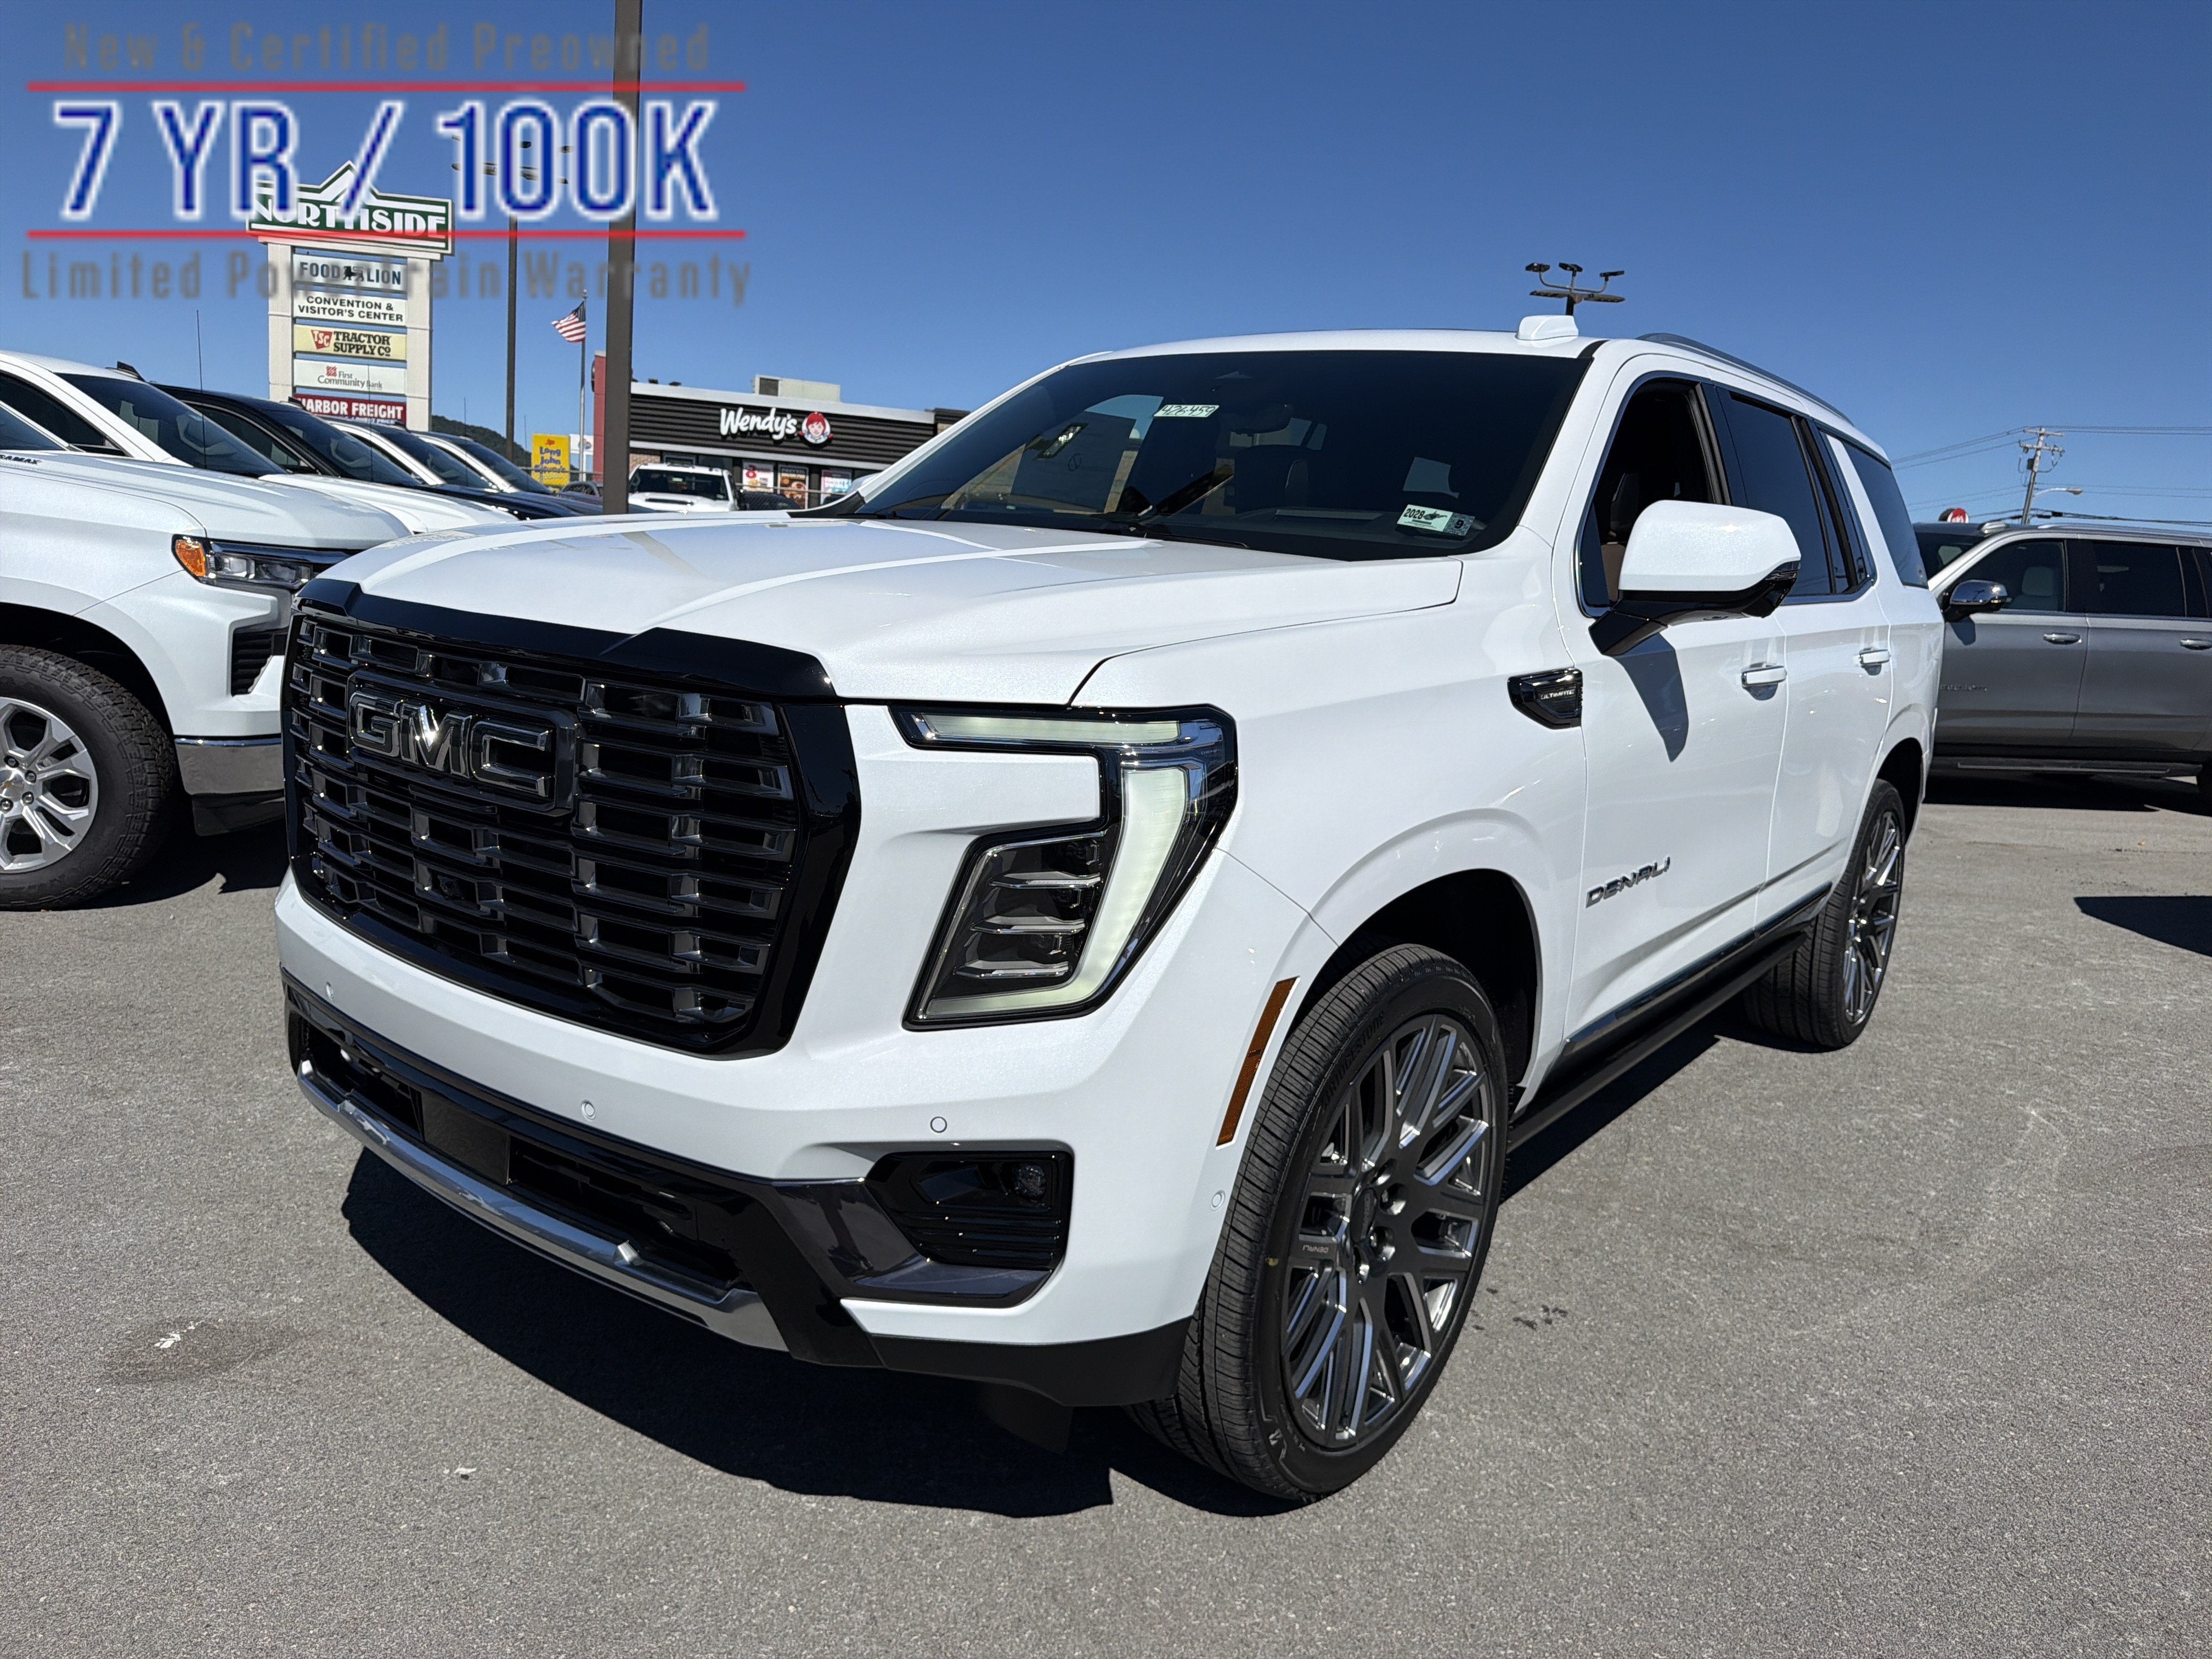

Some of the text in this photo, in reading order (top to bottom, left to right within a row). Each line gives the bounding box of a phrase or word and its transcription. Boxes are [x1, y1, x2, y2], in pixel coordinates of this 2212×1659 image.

[300, 262, 401, 285] FOOD LION
[306, 296, 394, 311] CONVENTION &
[298, 304, 403, 322] VISITOR'S CENTER
[312, 331, 330, 347] TSC
[333, 331, 392, 345] TRACTOR
[333, 342, 378, 355] SUPPLY
[317, 375, 365, 389] Community
[338, 370, 353, 379] First
[351, 402, 404, 419] FREIGHT
[720, 407, 798, 440] Wendy's
[1403, 508, 1426, 520] 2028
[1454, 519, 1465, 529] 9
[349, 691, 550, 798] GMC
[1585, 855, 1671, 909] DENALI
